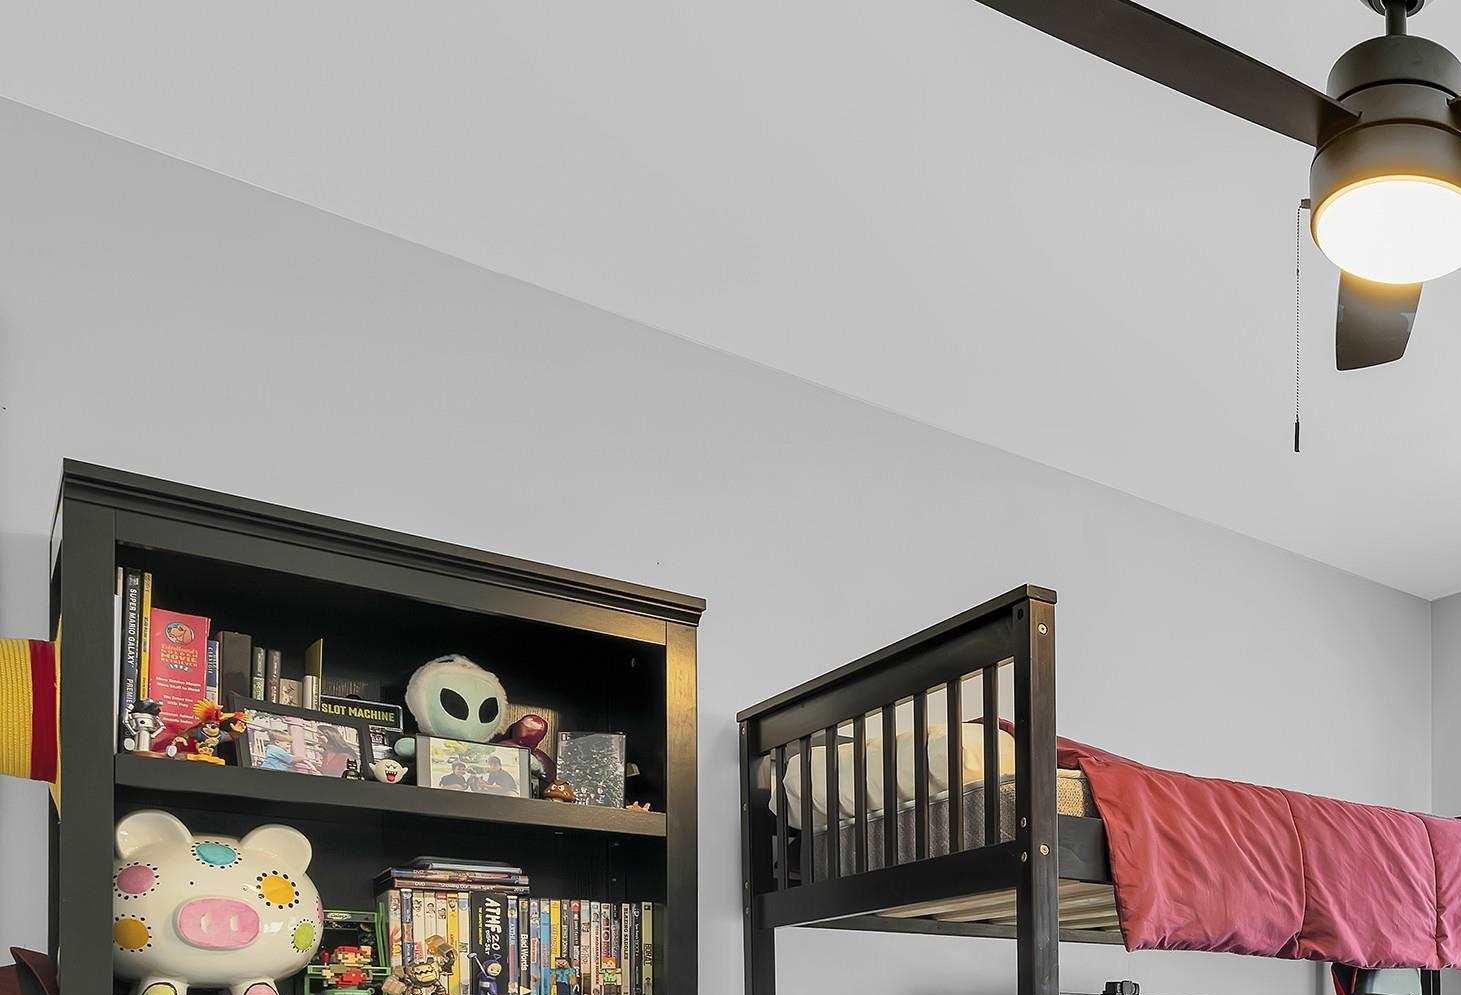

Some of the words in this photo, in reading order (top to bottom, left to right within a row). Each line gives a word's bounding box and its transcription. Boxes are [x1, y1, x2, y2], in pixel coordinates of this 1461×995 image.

[129, 589, 137, 611] SUPER
[127, 636, 135, 664] GALAXY
[160, 653, 197, 663] MOVIE
[321, 703, 347, 714] SLOT
[349, 707, 395, 722] MACHINE
[485, 898, 502, 934] ATHF
[491, 934, 501, 950] 20
